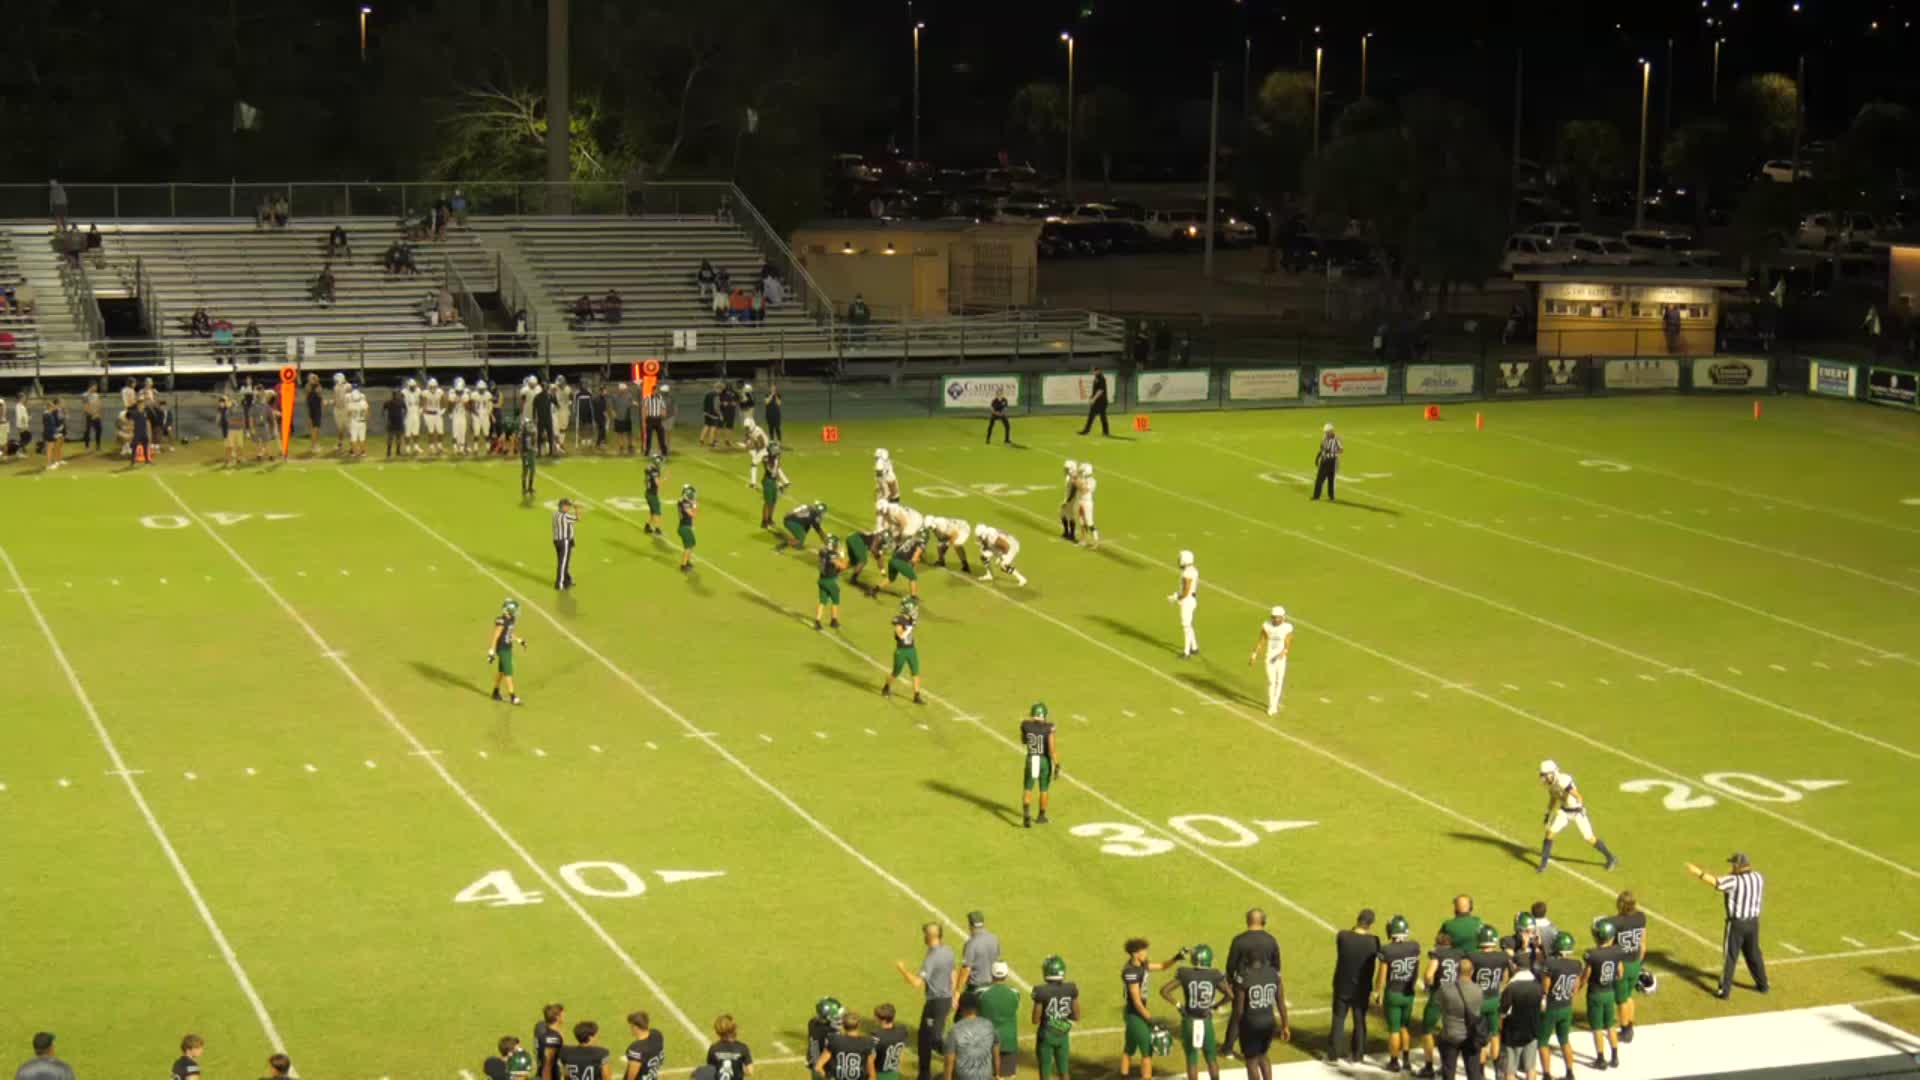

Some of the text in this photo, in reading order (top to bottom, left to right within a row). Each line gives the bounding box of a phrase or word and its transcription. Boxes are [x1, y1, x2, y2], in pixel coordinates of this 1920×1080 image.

[1026, 732, 1045, 754] 21
[1619, 771, 1803, 811] 20
[1068, 813, 1262, 857] 30
[453, 859, 646, 907] 40
[1390, 955, 1418, 981] 25
[1188, 980, 1215, 1009] 13
[1248, 983, 1278, 1009] 90
[836, 1051, 862, 1080] 18
